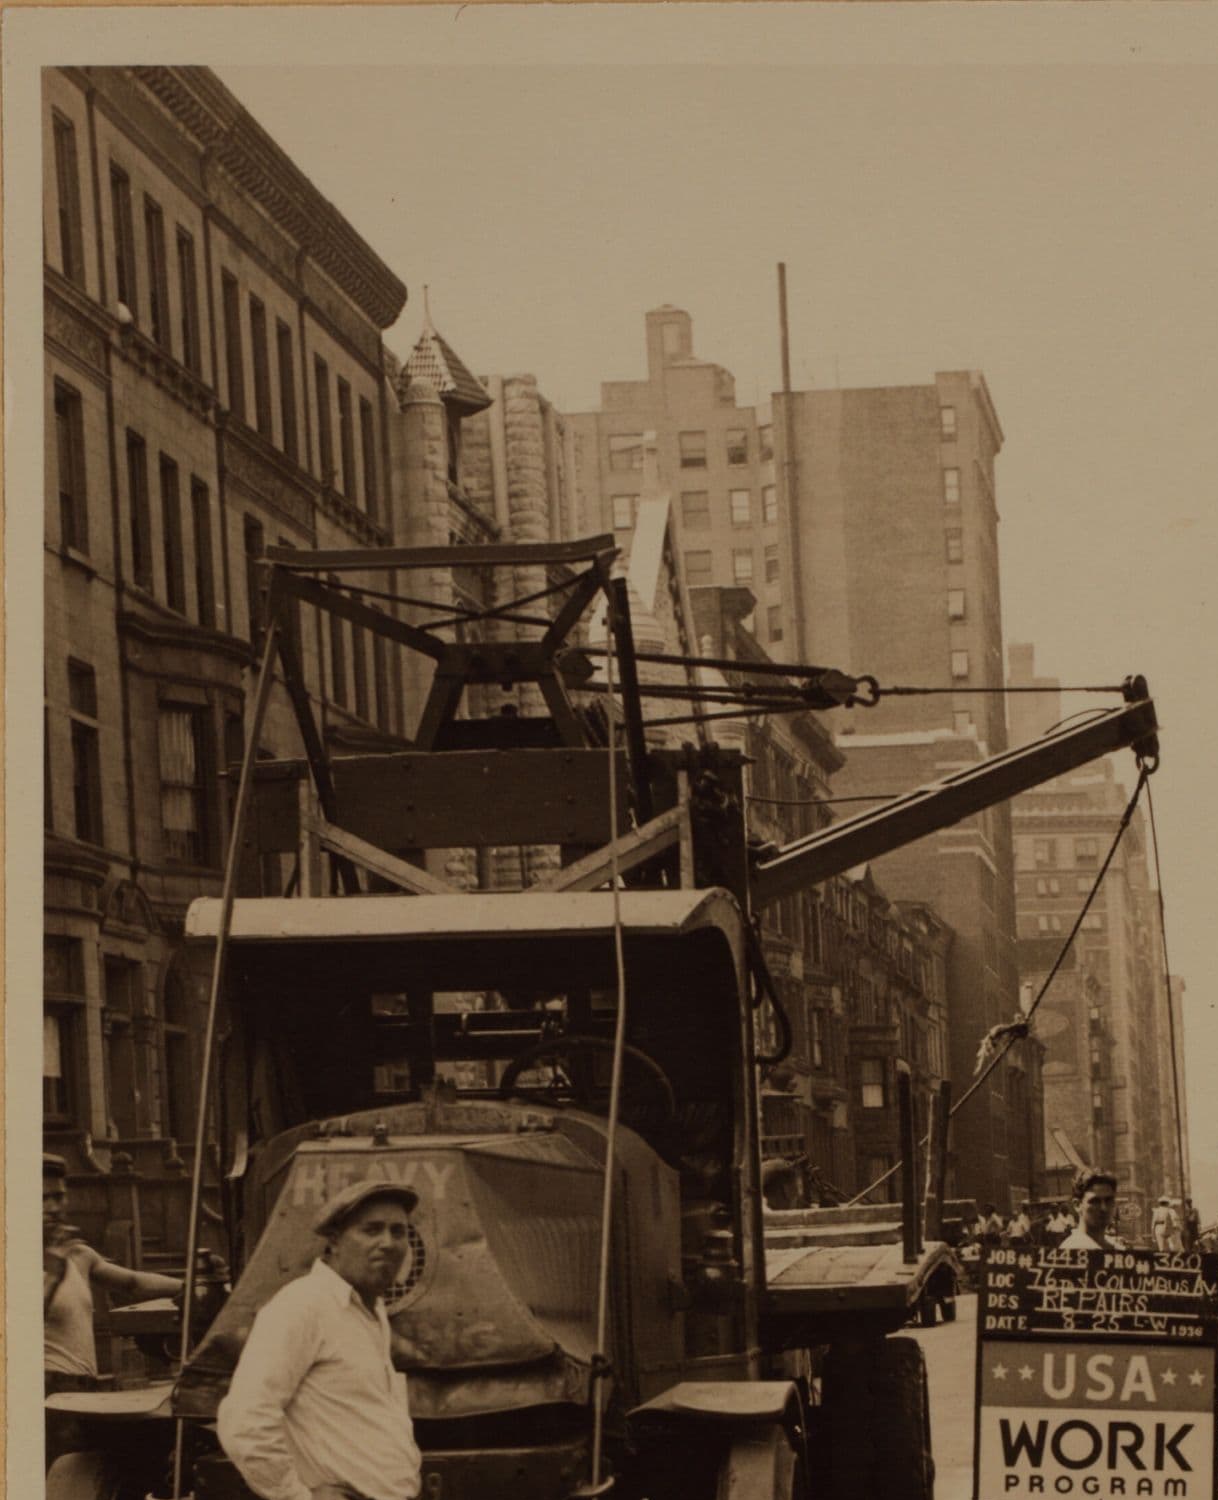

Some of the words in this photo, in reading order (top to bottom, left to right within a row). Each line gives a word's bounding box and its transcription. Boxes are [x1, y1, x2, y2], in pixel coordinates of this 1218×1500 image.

[1037, 1247, 1089, 1267] 1448
[1153, 1252, 1202, 1270] 360
[987, 1272, 1016, 1288] LOC
[1095, 1269, 1190, 1294] COLUMBUS
[987, 1293, 1019, 1310] DES
[1042, 1288, 1149, 1313] REPAIRS
[985, 1315, 1028, 1330] DATE
[1042, 1353, 1157, 1402] USA
[999, 1418, 1195, 1473] WORK
[1004, 1475, 1187, 1497] PROGRAM
